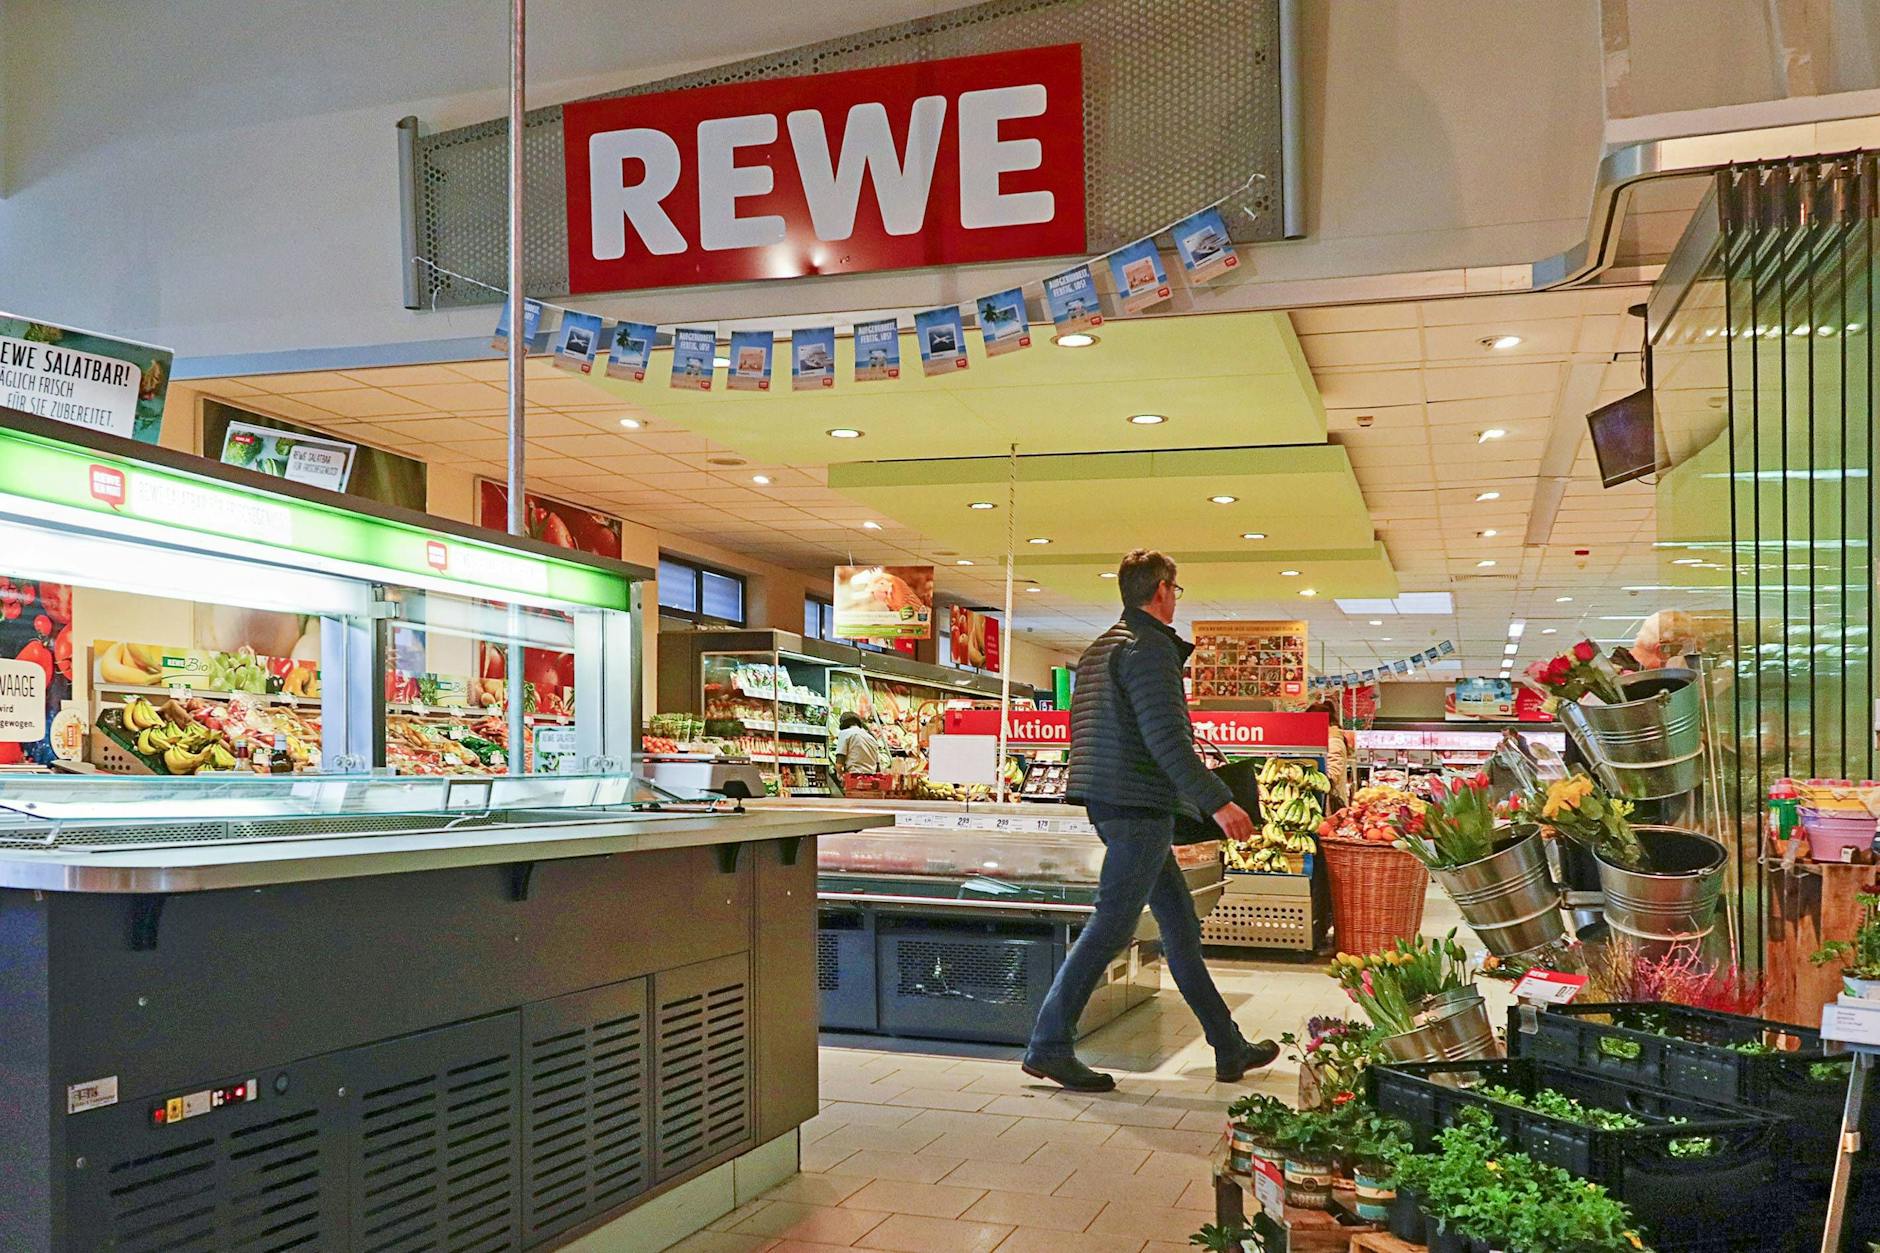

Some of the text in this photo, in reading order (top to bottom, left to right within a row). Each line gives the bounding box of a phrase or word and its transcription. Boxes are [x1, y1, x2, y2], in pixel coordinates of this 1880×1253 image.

[588, 84, 1055, 261] REWE
[0, 341, 130, 387] EWE SALATBAR!
[39, 375, 74, 398] FRISCH
[7, 392, 114, 428] FÜR SIE ZUBEREITET.
[185, 657, 209, 671] Bio
[1001, 719, 1067, 739] Aktion
